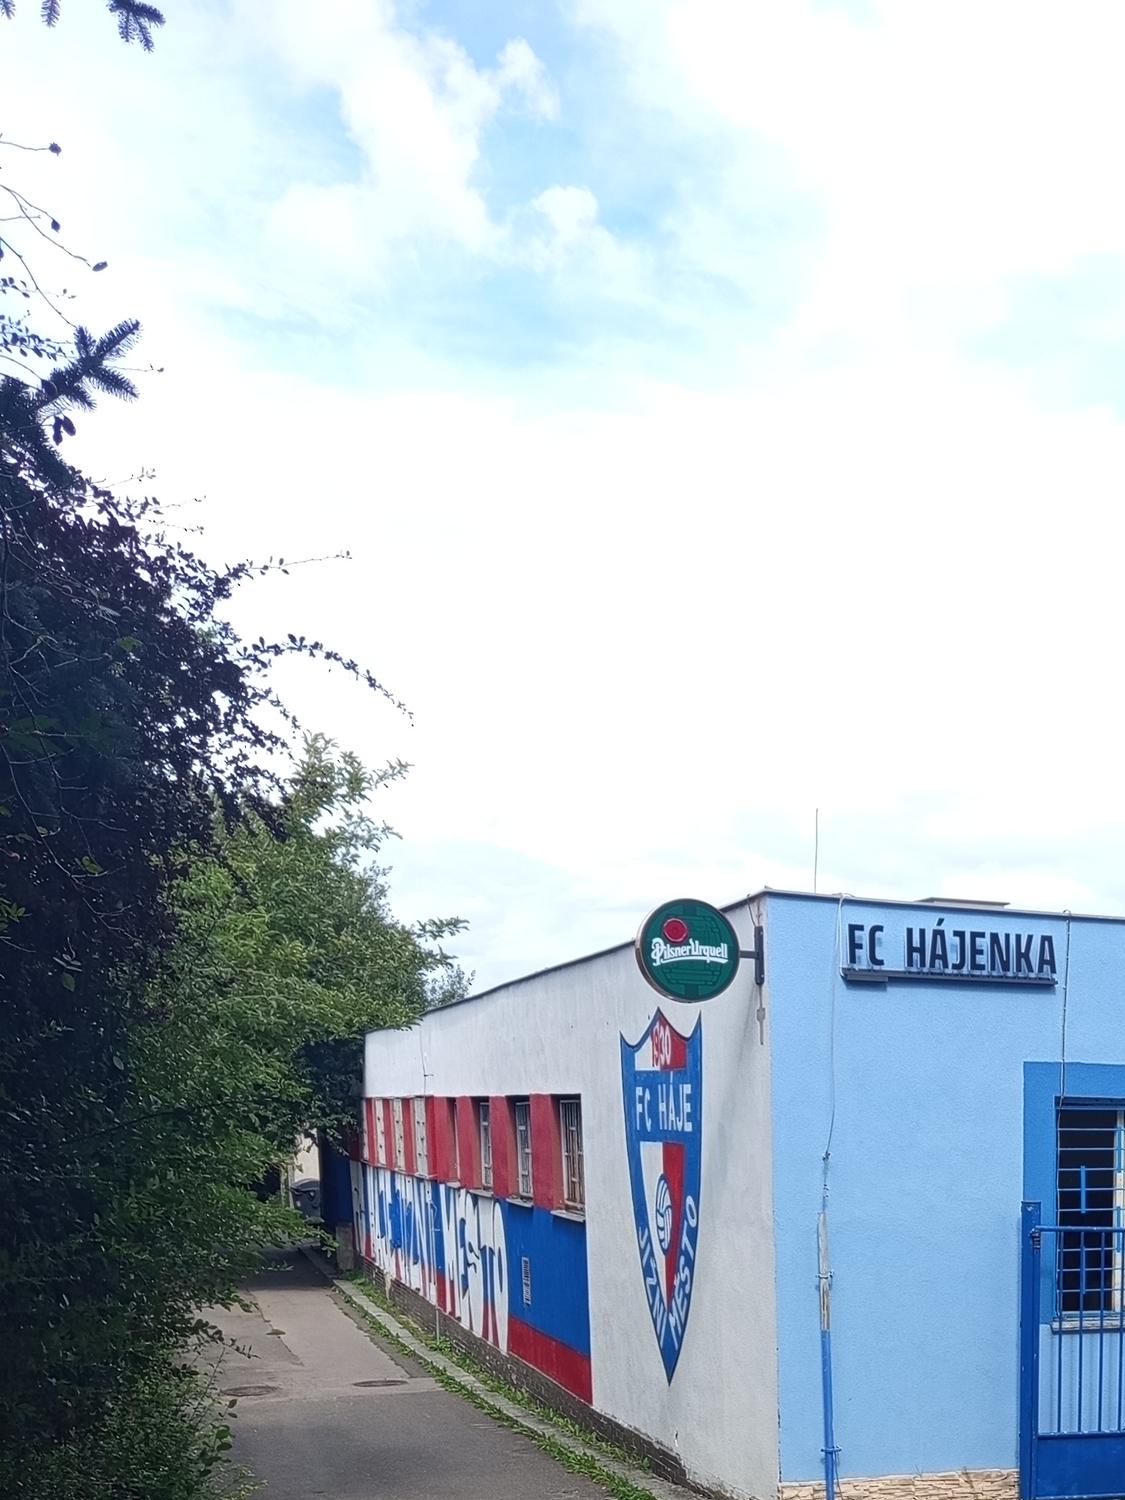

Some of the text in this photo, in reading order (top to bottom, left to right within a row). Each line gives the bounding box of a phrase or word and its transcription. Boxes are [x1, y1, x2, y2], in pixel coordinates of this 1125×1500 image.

[651, 937, 728, 966] Pilsner Urquell
[847, 918, 1057, 974] FC HÁJENKA
[635, 1071, 692, 1132] FC HÁJE
[668, 1195, 697, 1350] MĚSTO
